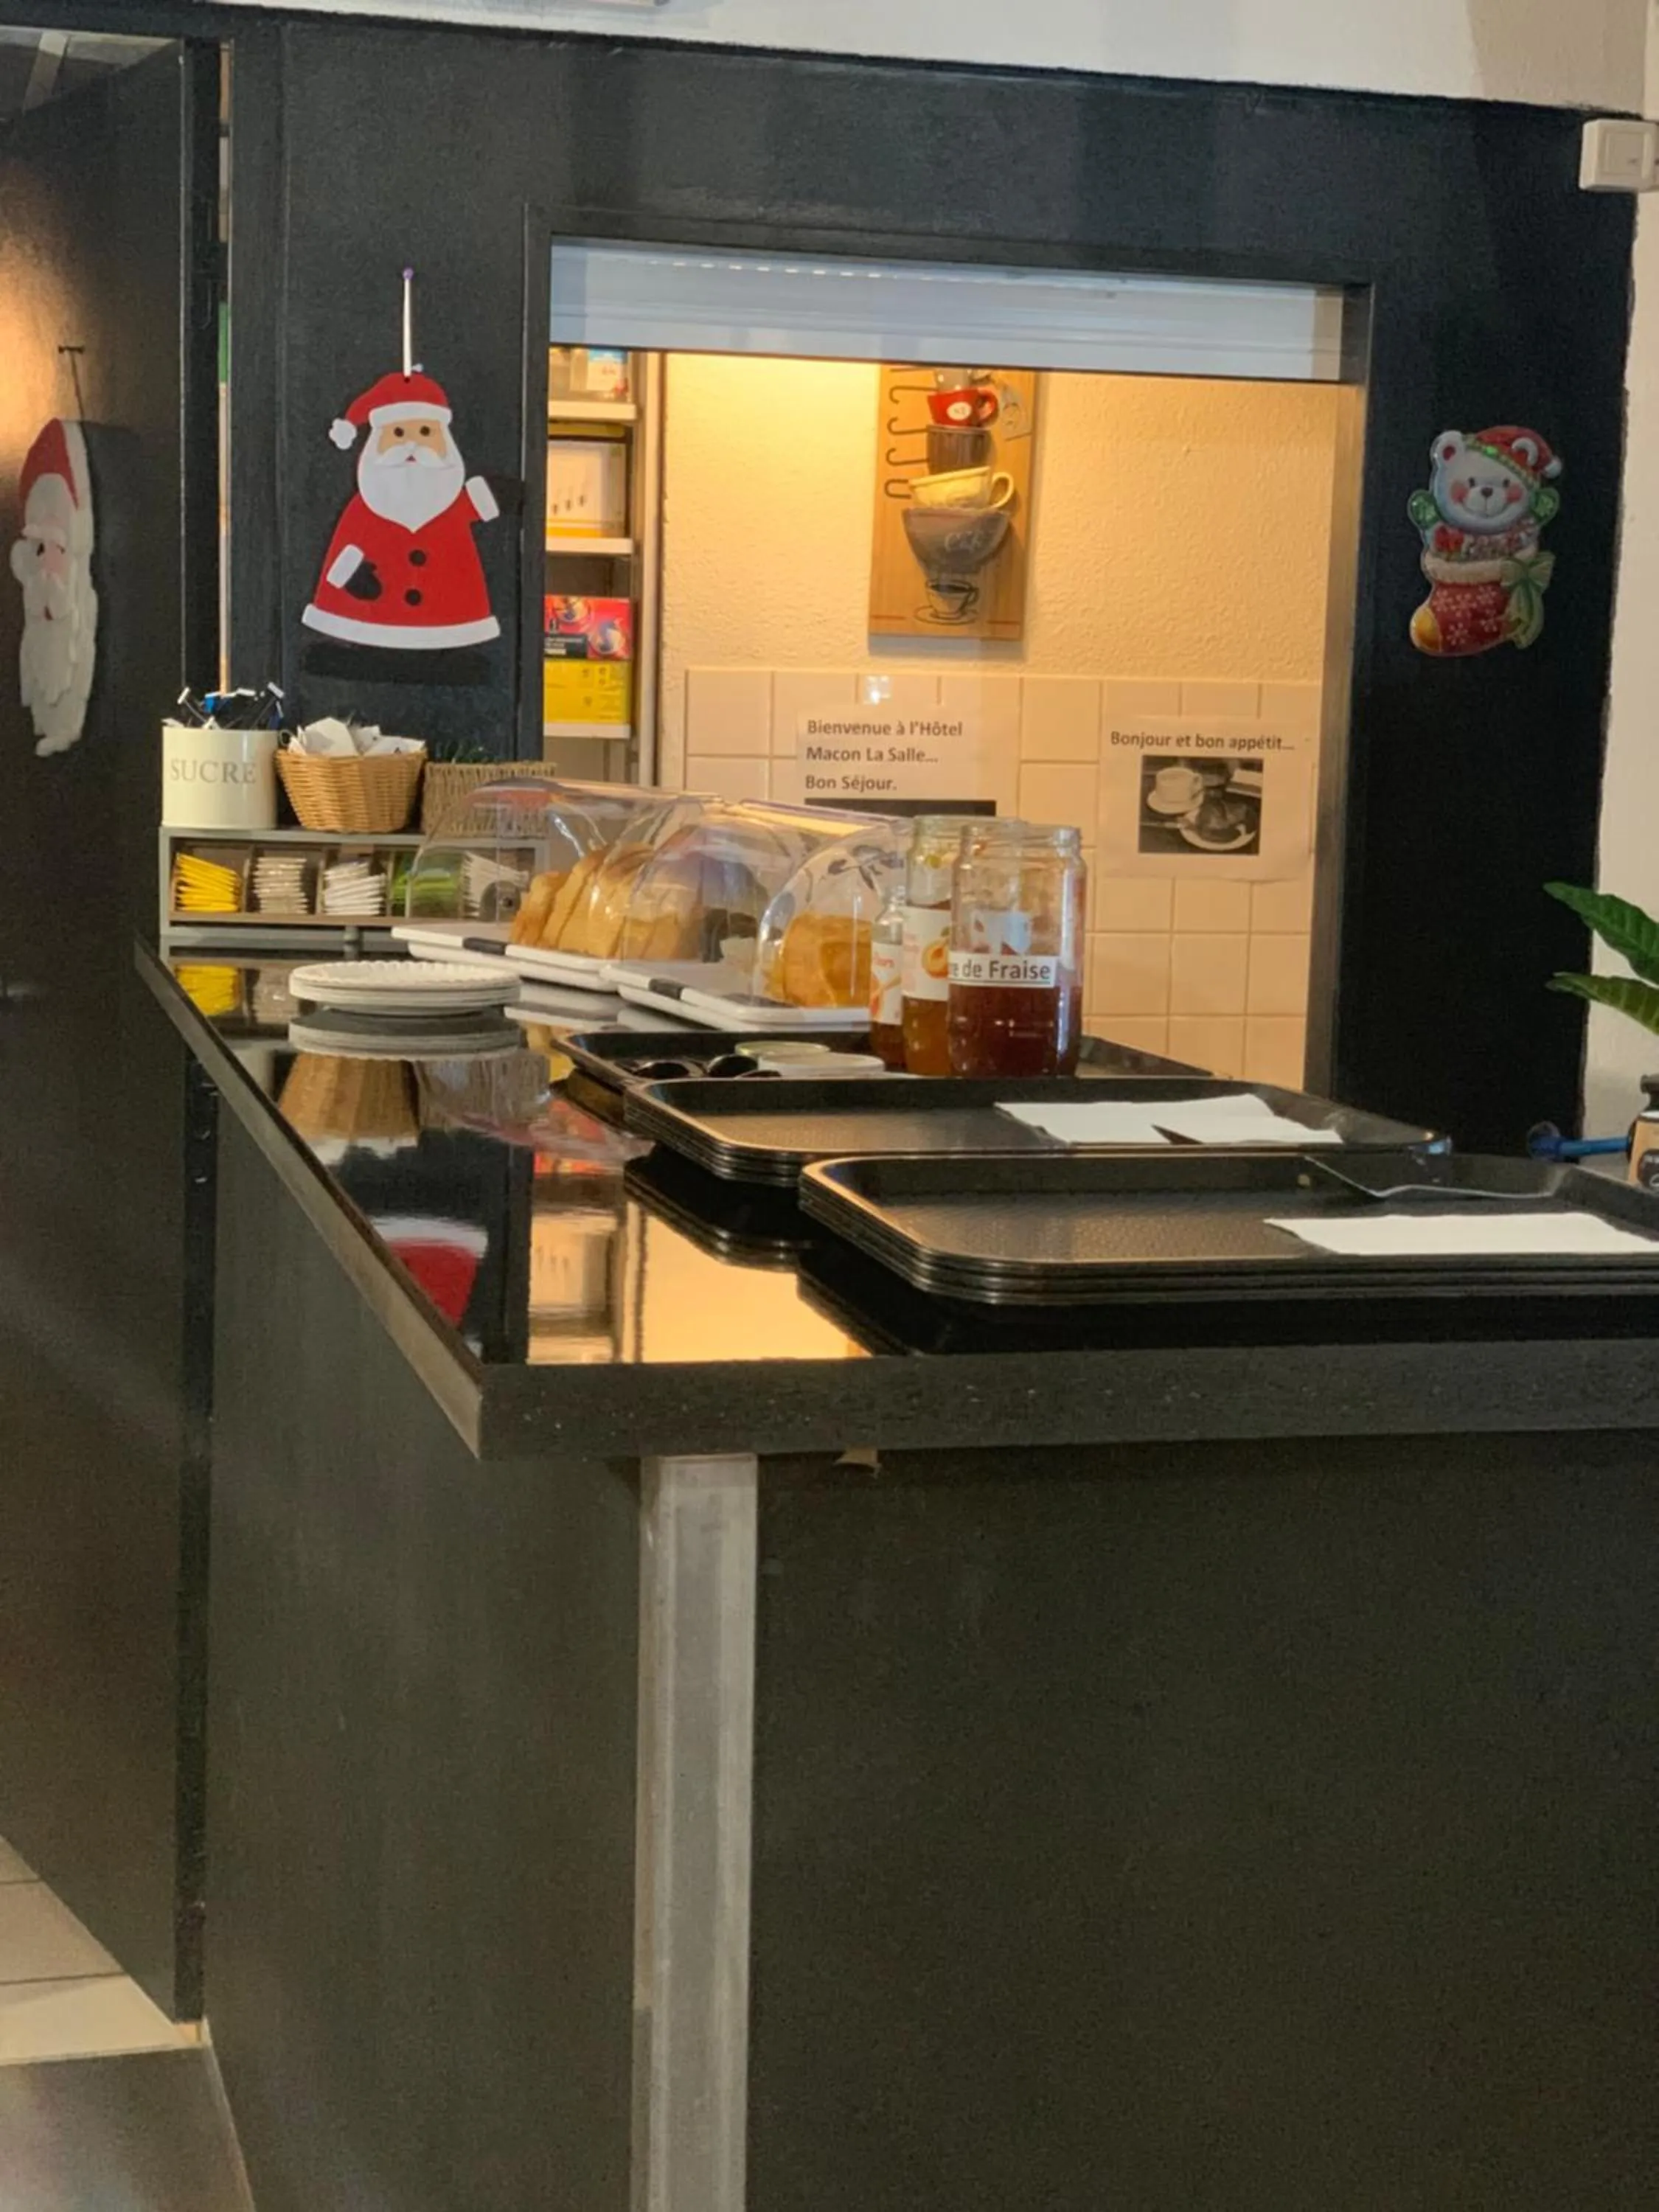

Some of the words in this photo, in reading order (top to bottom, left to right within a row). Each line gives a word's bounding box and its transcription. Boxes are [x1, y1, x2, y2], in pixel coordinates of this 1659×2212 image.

[807, 720, 891, 736] Bienvenue
[897, 721, 905, 735] à
[1110, 731, 1170, 748] Bonjour
[1176, 735, 1191, 746] et
[1195, 734, 1224, 748] bon
[806, 747, 860, 761] Macon
[866, 748, 884, 762] La
[170, 758, 256, 784] SUCRE
[805, 776, 836, 790] Bon
[841, 776, 897, 793] Séjour.
[962, 959, 982, 978] de
[989, 960, 1051, 980] Fraise
